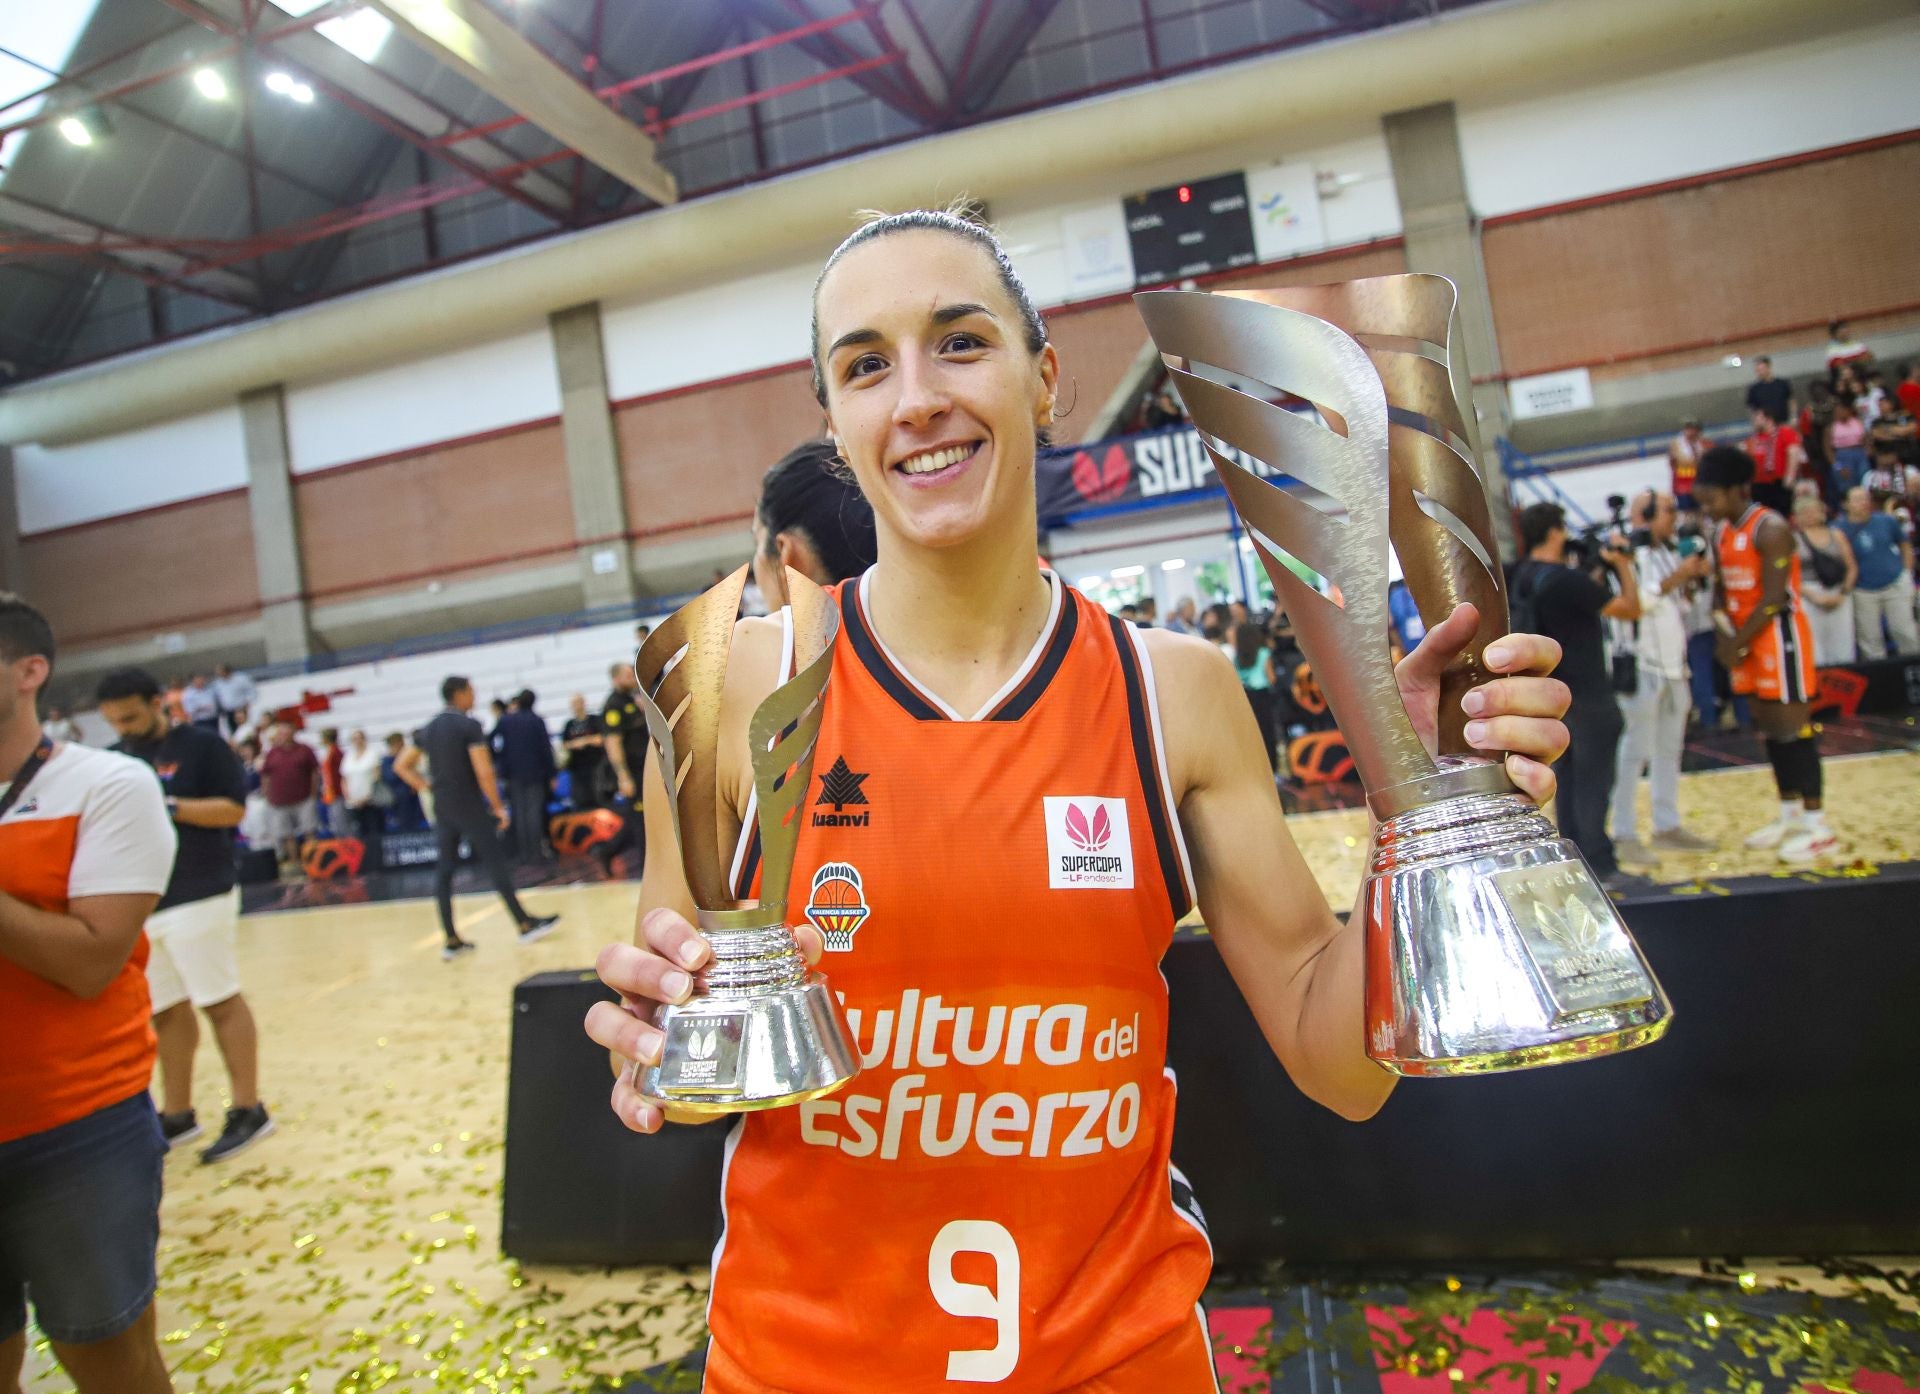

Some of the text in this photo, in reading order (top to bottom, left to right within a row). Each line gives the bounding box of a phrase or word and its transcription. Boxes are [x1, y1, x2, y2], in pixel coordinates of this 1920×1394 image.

[812, 811, 870, 827] luanvi
[1062, 856, 1122, 872] SUPERCOPA
[1069, 874, 1116, 883] LF endesa
[836, 989, 1140, 1070] ultura del
[800, 1074, 1140, 1160] Esfuerzo
[928, 1220, 1021, 1383] 9
